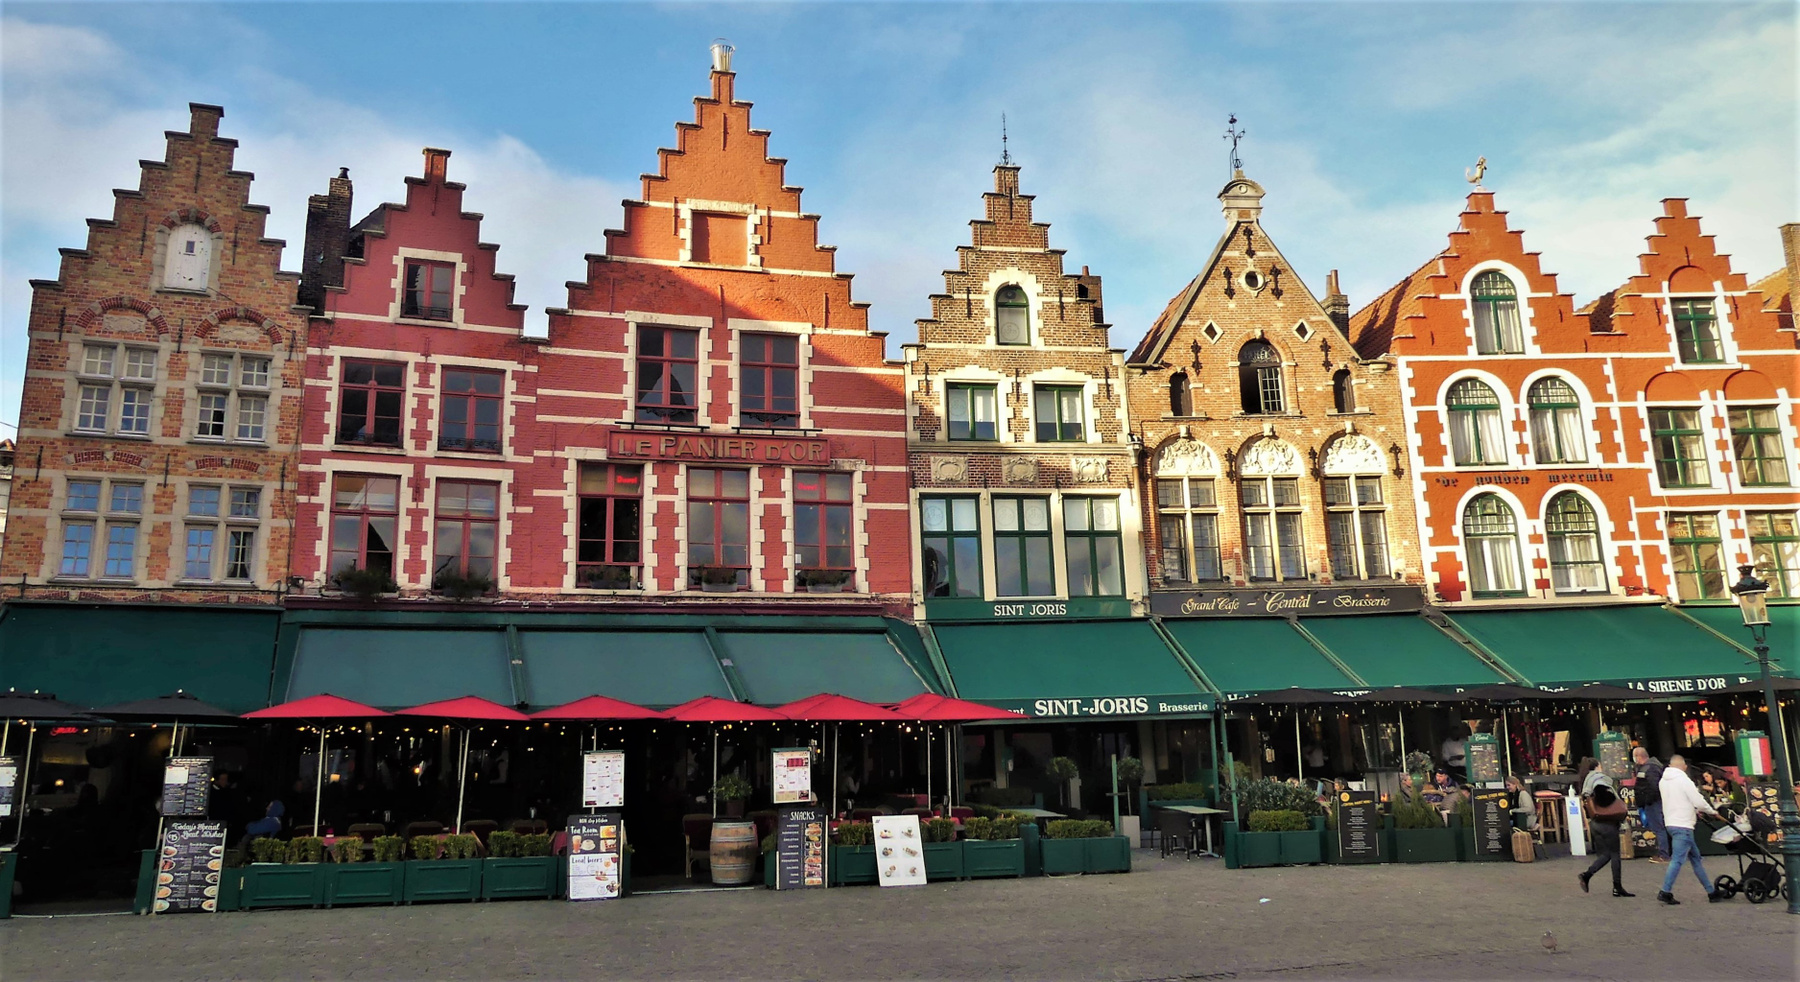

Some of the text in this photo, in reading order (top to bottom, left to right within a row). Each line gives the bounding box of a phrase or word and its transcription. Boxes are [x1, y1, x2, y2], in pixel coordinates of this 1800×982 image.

[618, 436, 824, 462] LE PANIER D'OR
[994, 604, 1067, 616] SINT JORIS
[1181, 598, 1216, 614] Grand
[1263, 592, 1311, 613] Central
[1333, 595, 1391, 607] Brasserie
[1648, 680, 1694, 693] SIRENE
[1696, 677, 1727, 690] D'OR
[1034, 697, 1149, 716] SINT-JORIS
[1158, 702, 1209, 713] Brasserie
[790, 811, 815, 821] SNACKS
[570, 826, 581, 834] Tea
[571, 856, 586, 864] Local
